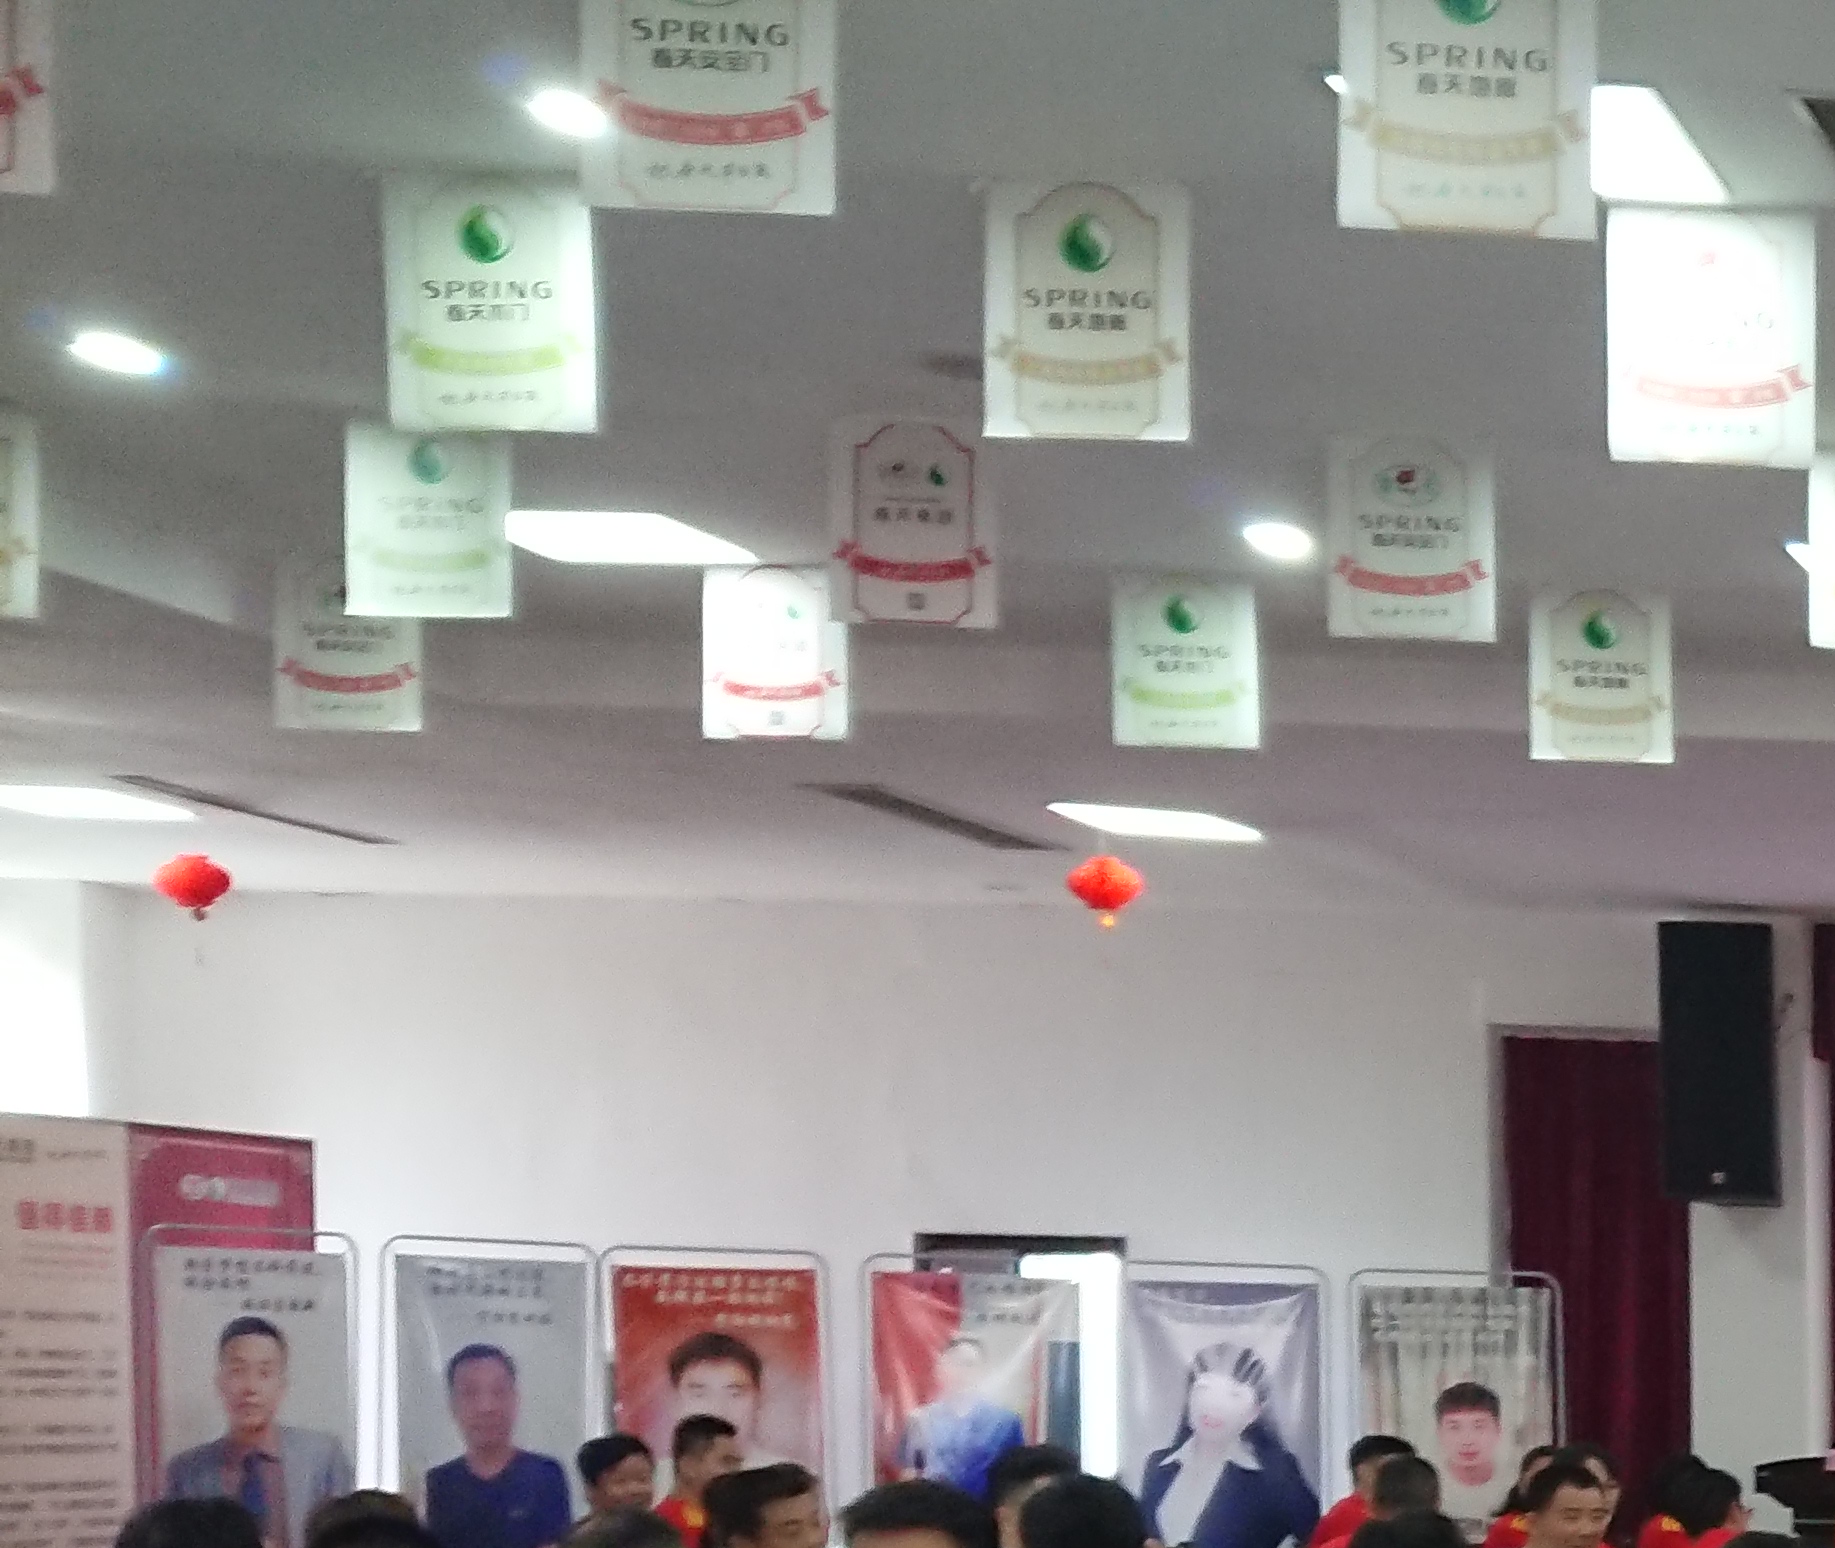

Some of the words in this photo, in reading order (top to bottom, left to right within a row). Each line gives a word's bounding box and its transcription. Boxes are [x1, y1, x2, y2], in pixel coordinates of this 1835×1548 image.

[630, 17, 791, 47] SPRING
[1386, 41, 1550, 73] SPRING
[421, 279, 554, 300] SPRING
[1022, 287, 1153, 311] SPRING
